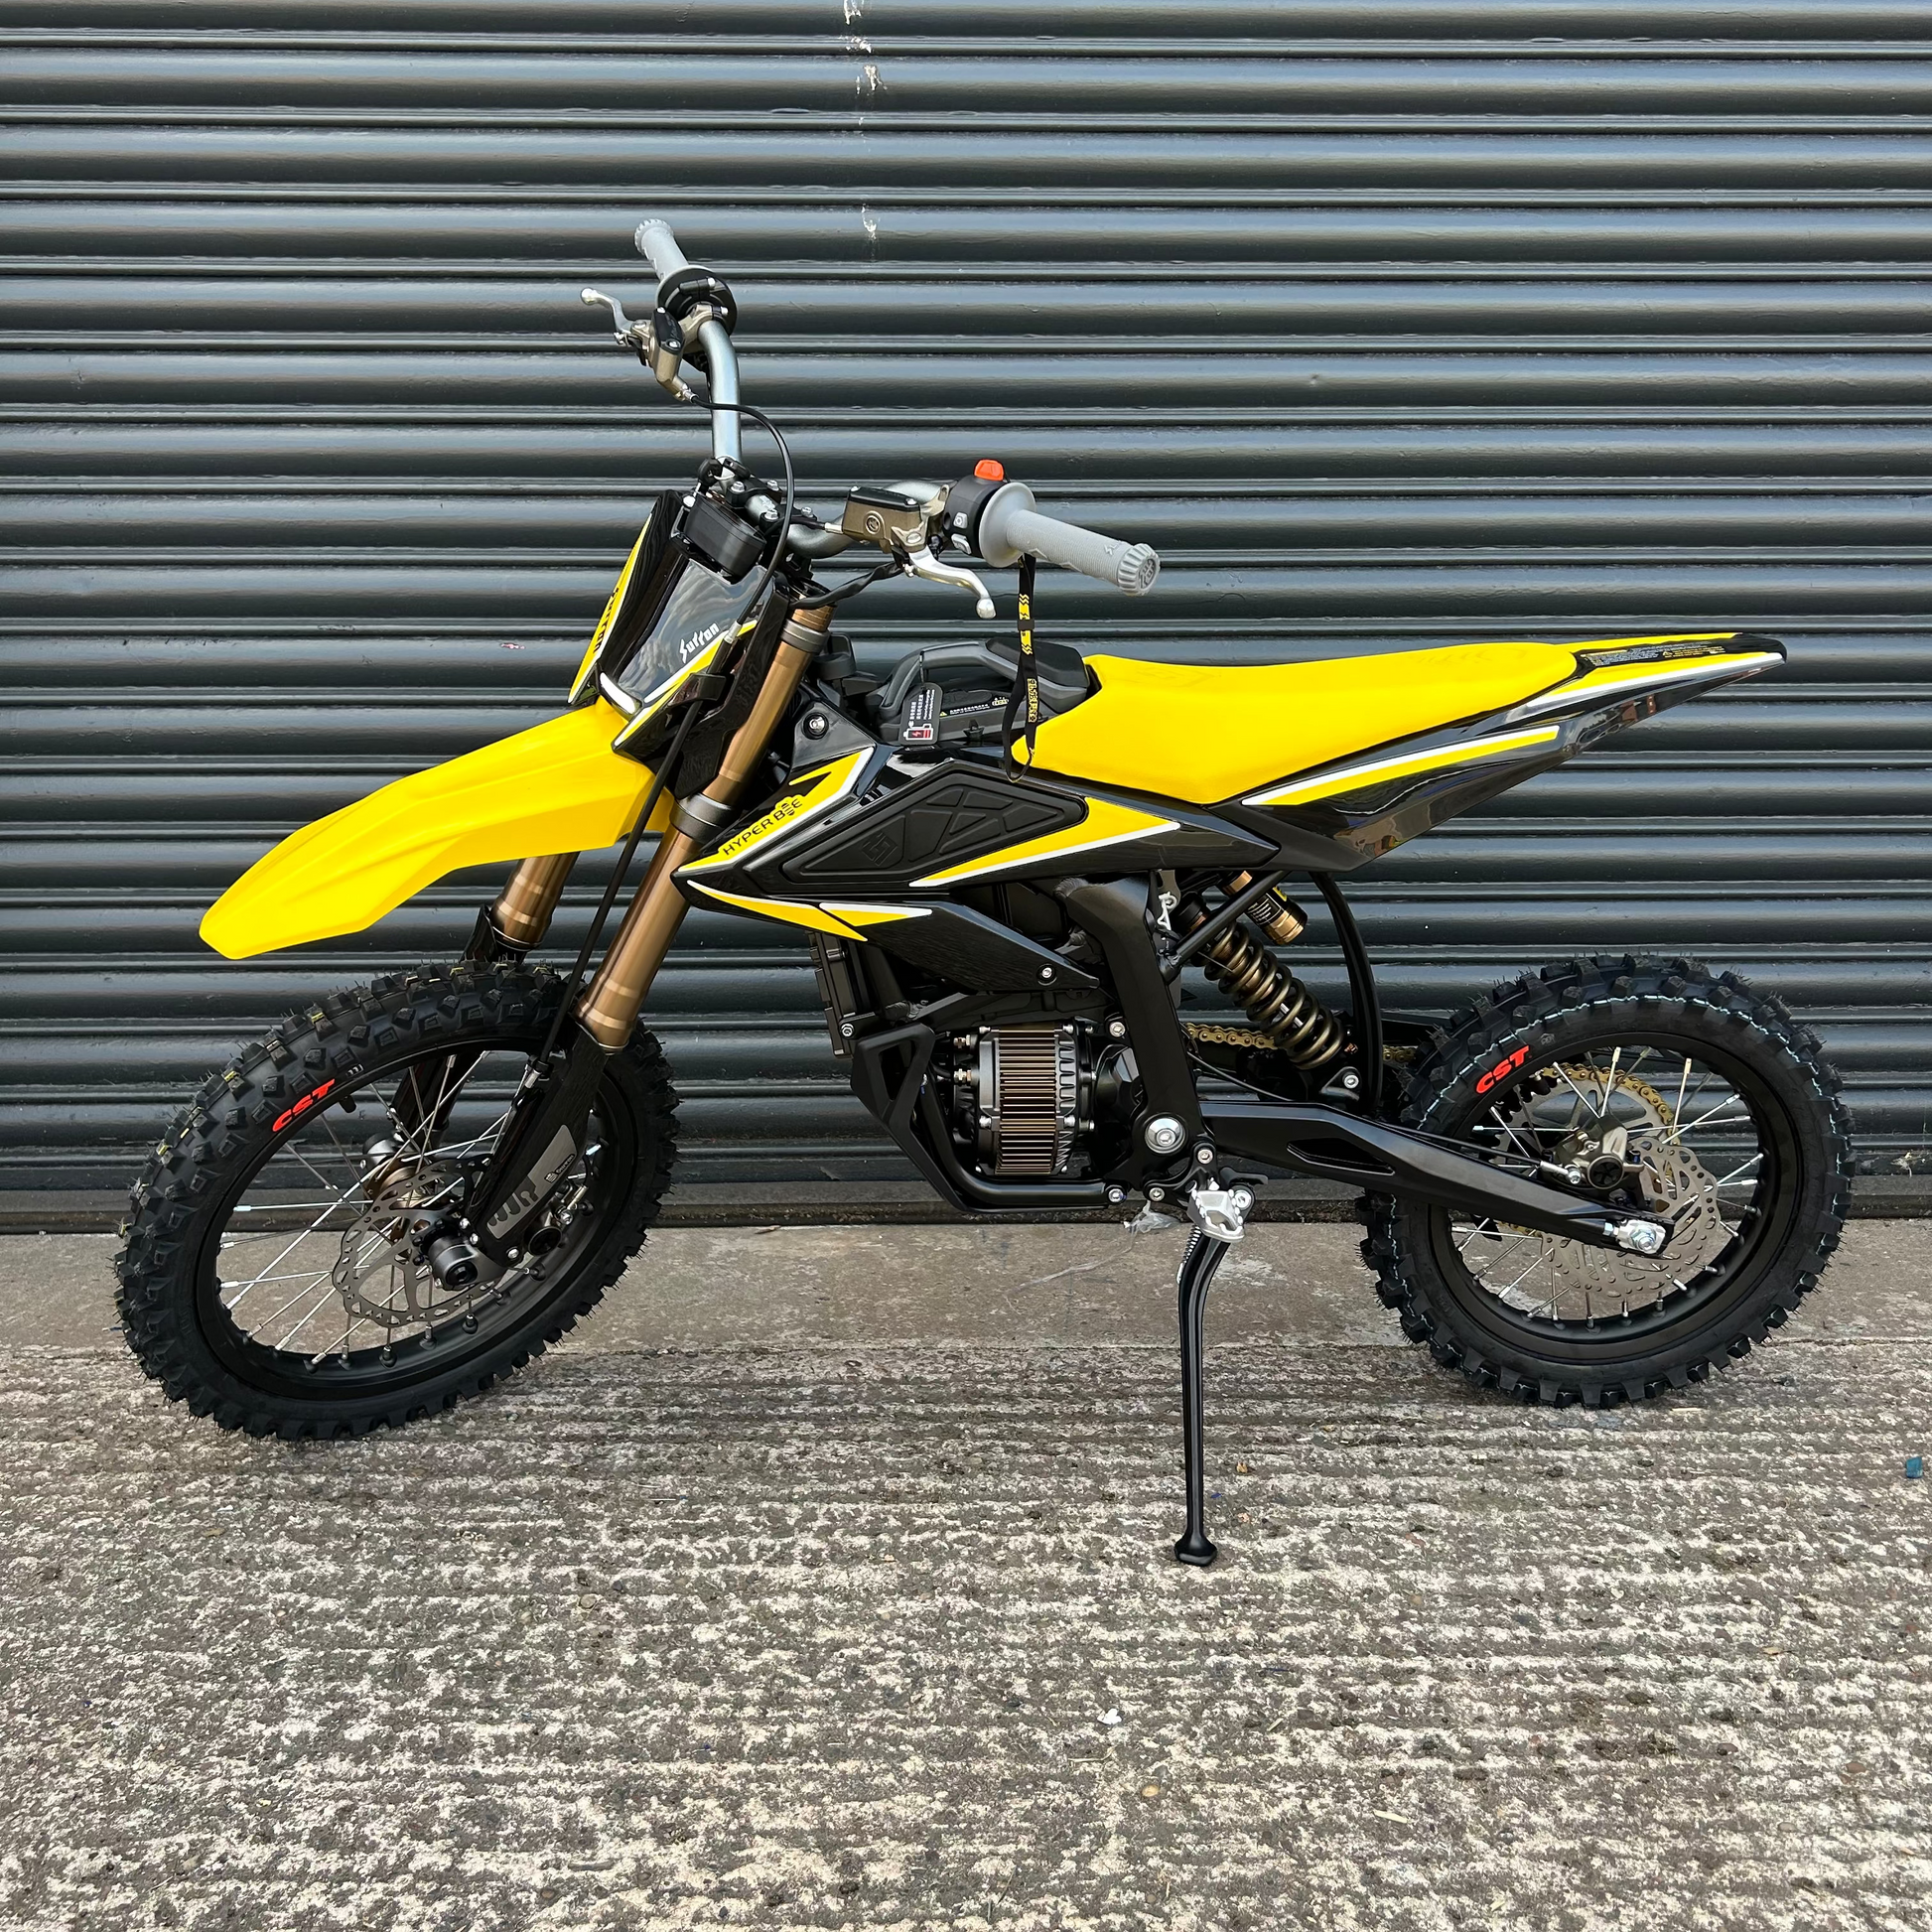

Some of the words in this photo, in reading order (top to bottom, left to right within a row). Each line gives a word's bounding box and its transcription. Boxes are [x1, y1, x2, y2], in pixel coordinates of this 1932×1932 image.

[723, 818, 774, 856] HYPER
[1475, 1044, 1530, 1094] CST
[272, 1078, 336, 1132] CST
